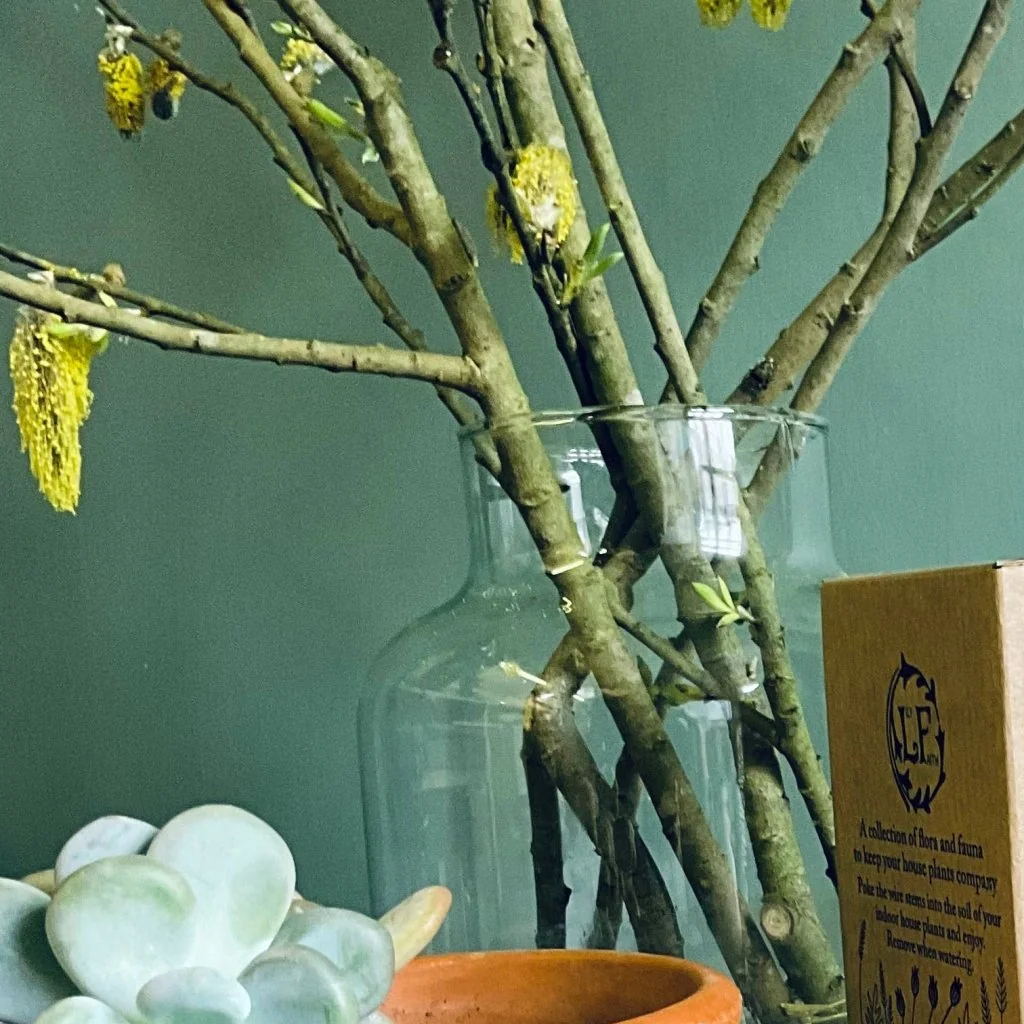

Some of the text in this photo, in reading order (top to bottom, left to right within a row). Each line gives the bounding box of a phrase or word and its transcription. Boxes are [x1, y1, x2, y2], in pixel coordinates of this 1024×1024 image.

[860, 818, 984, 859] A collection of flora and fauna
[863, 845, 882, 874] keep
[882, 855, 901, 875] your
[902, 851, 927, 877] house
[928, 858, 956, 886] plants
[957, 870, 998, 898] company
[876, 881, 889, 900] the
[927, 893, 943, 913] into
[944, 896, 957, 917] the
[958, 902, 972, 920] soil
[973, 903, 983, 923] of
[983, 910, 1002, 931] your
[900, 909, 922, 932] house
[922, 916, 946, 944] plants
[947, 924, 961, 942] and
[963, 928, 986, 955] enjoy.
[917, 942, 937, 960] when
